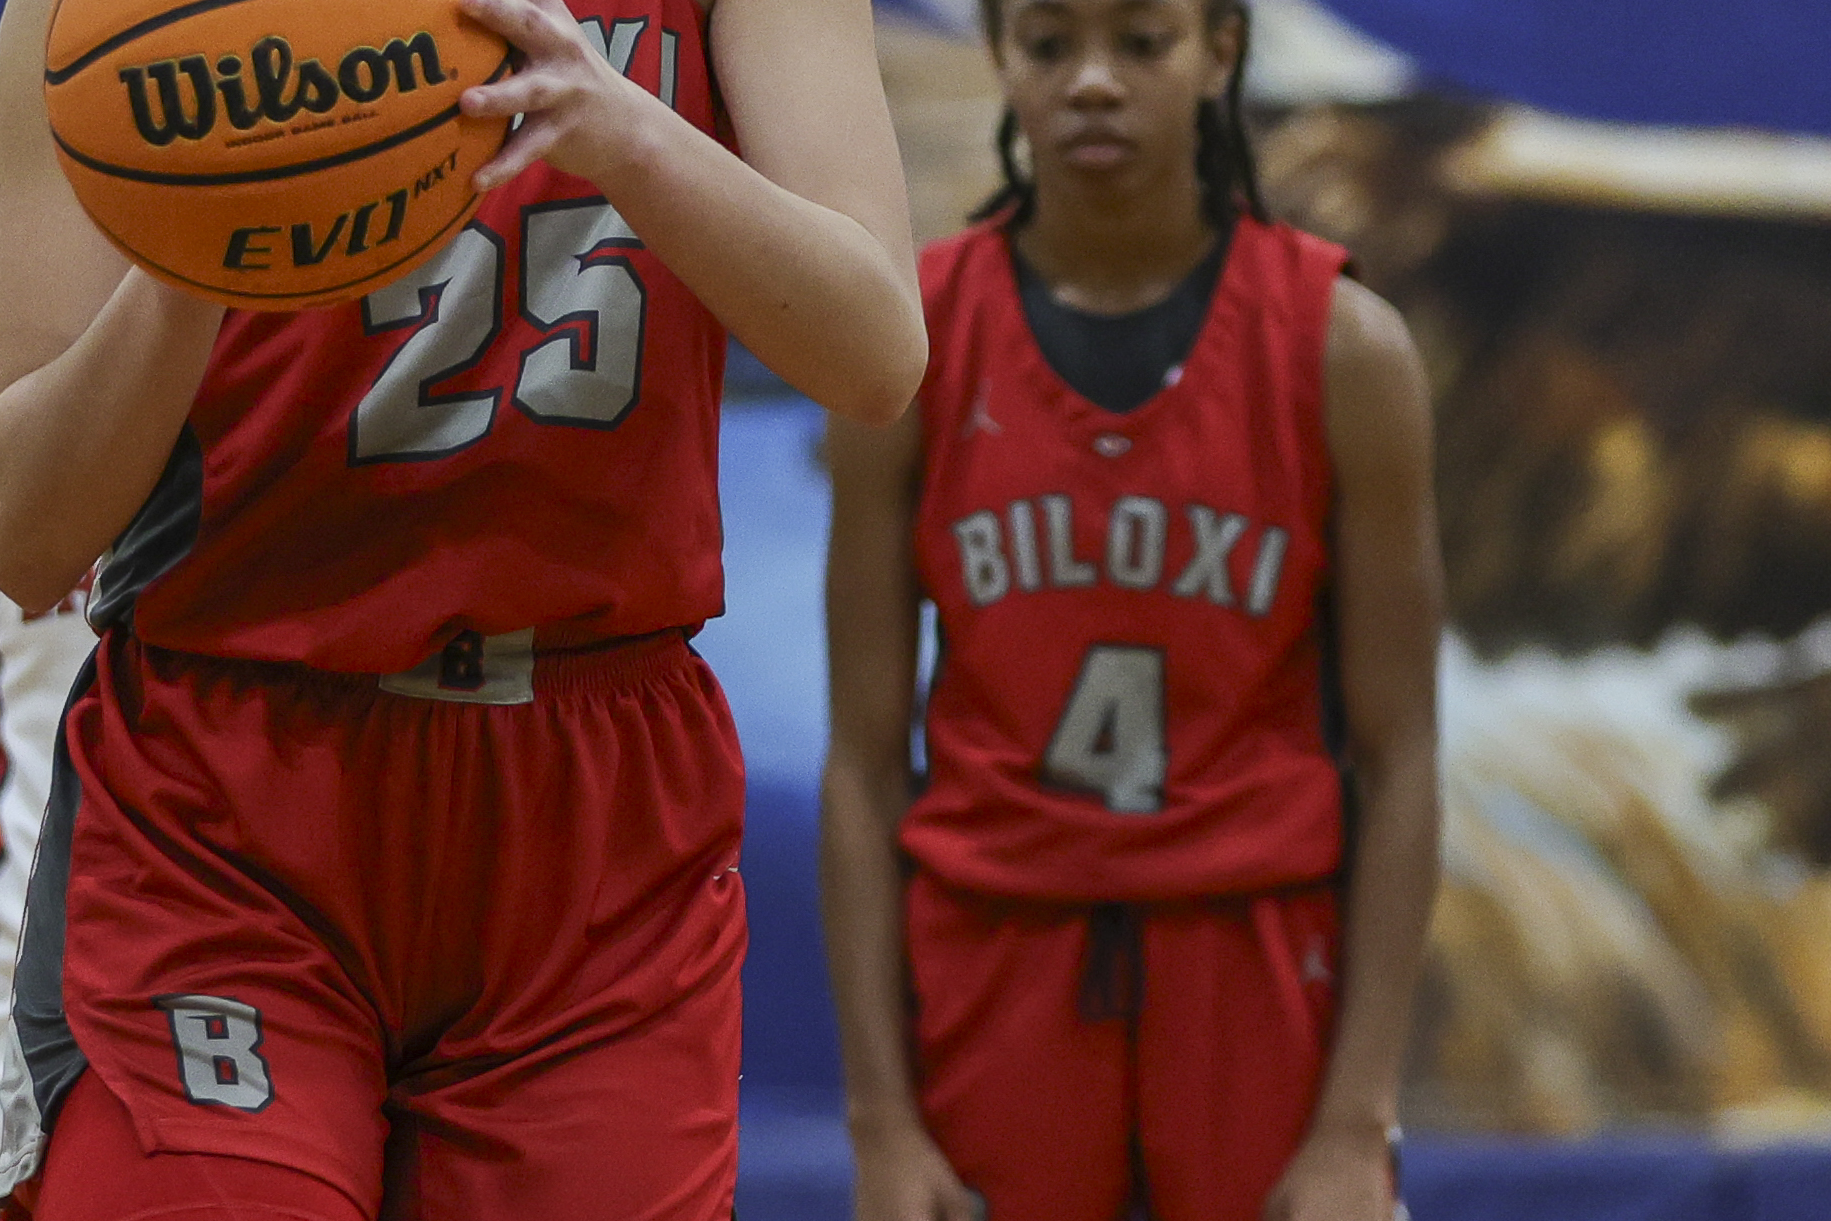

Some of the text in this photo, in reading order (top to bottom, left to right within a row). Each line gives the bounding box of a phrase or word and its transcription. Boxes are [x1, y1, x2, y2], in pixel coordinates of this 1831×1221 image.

[118, 30, 450, 146] Wilson
[413, 147, 460, 199] NXT
[347, 193, 648, 468] 25
[950, 493, 1290, 618] BILOXI
[1038, 640, 1170, 816] 4
[150, 991, 274, 1113] B
